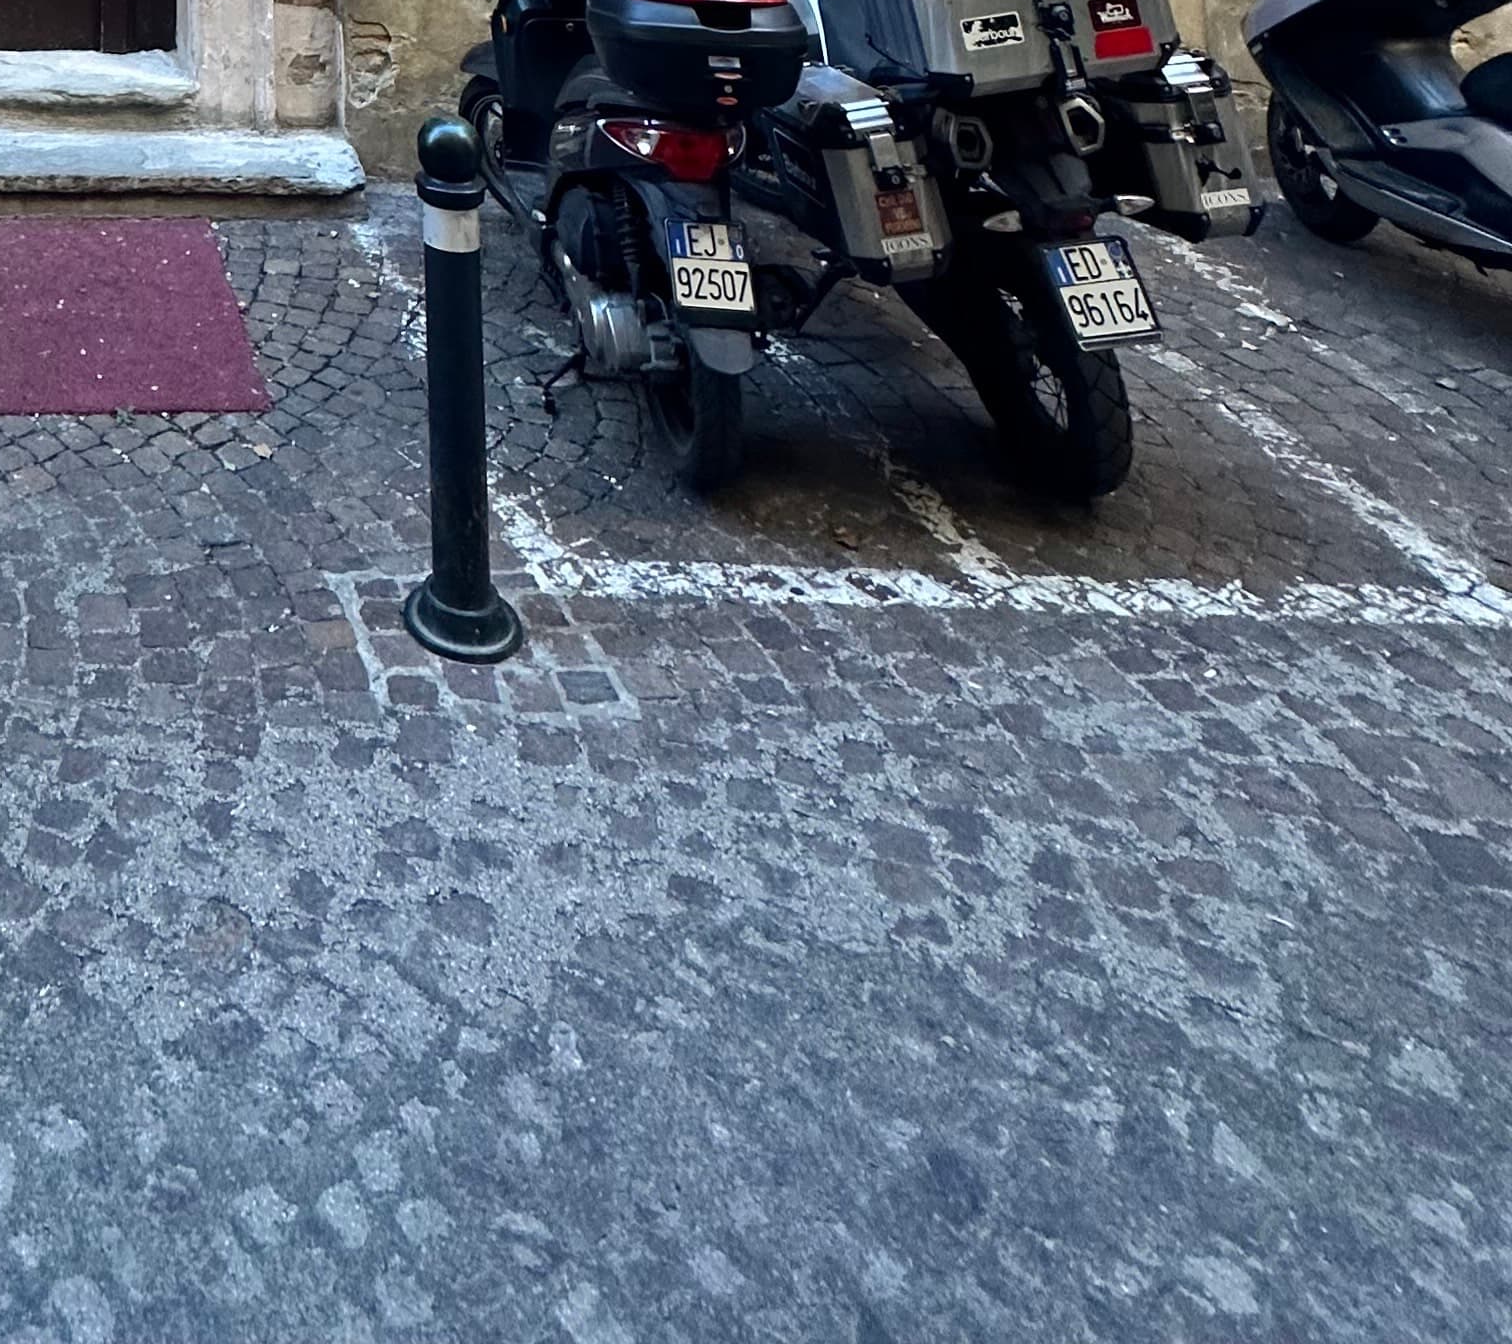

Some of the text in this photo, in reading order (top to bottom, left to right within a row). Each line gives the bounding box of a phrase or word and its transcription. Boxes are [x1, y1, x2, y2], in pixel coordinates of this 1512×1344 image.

[686, 225, 717, 257] EJ
[1062, 246, 1102, 281] ED
[677, 266, 748, 302] 92507
[1068, 287, 1149, 328] 96164
